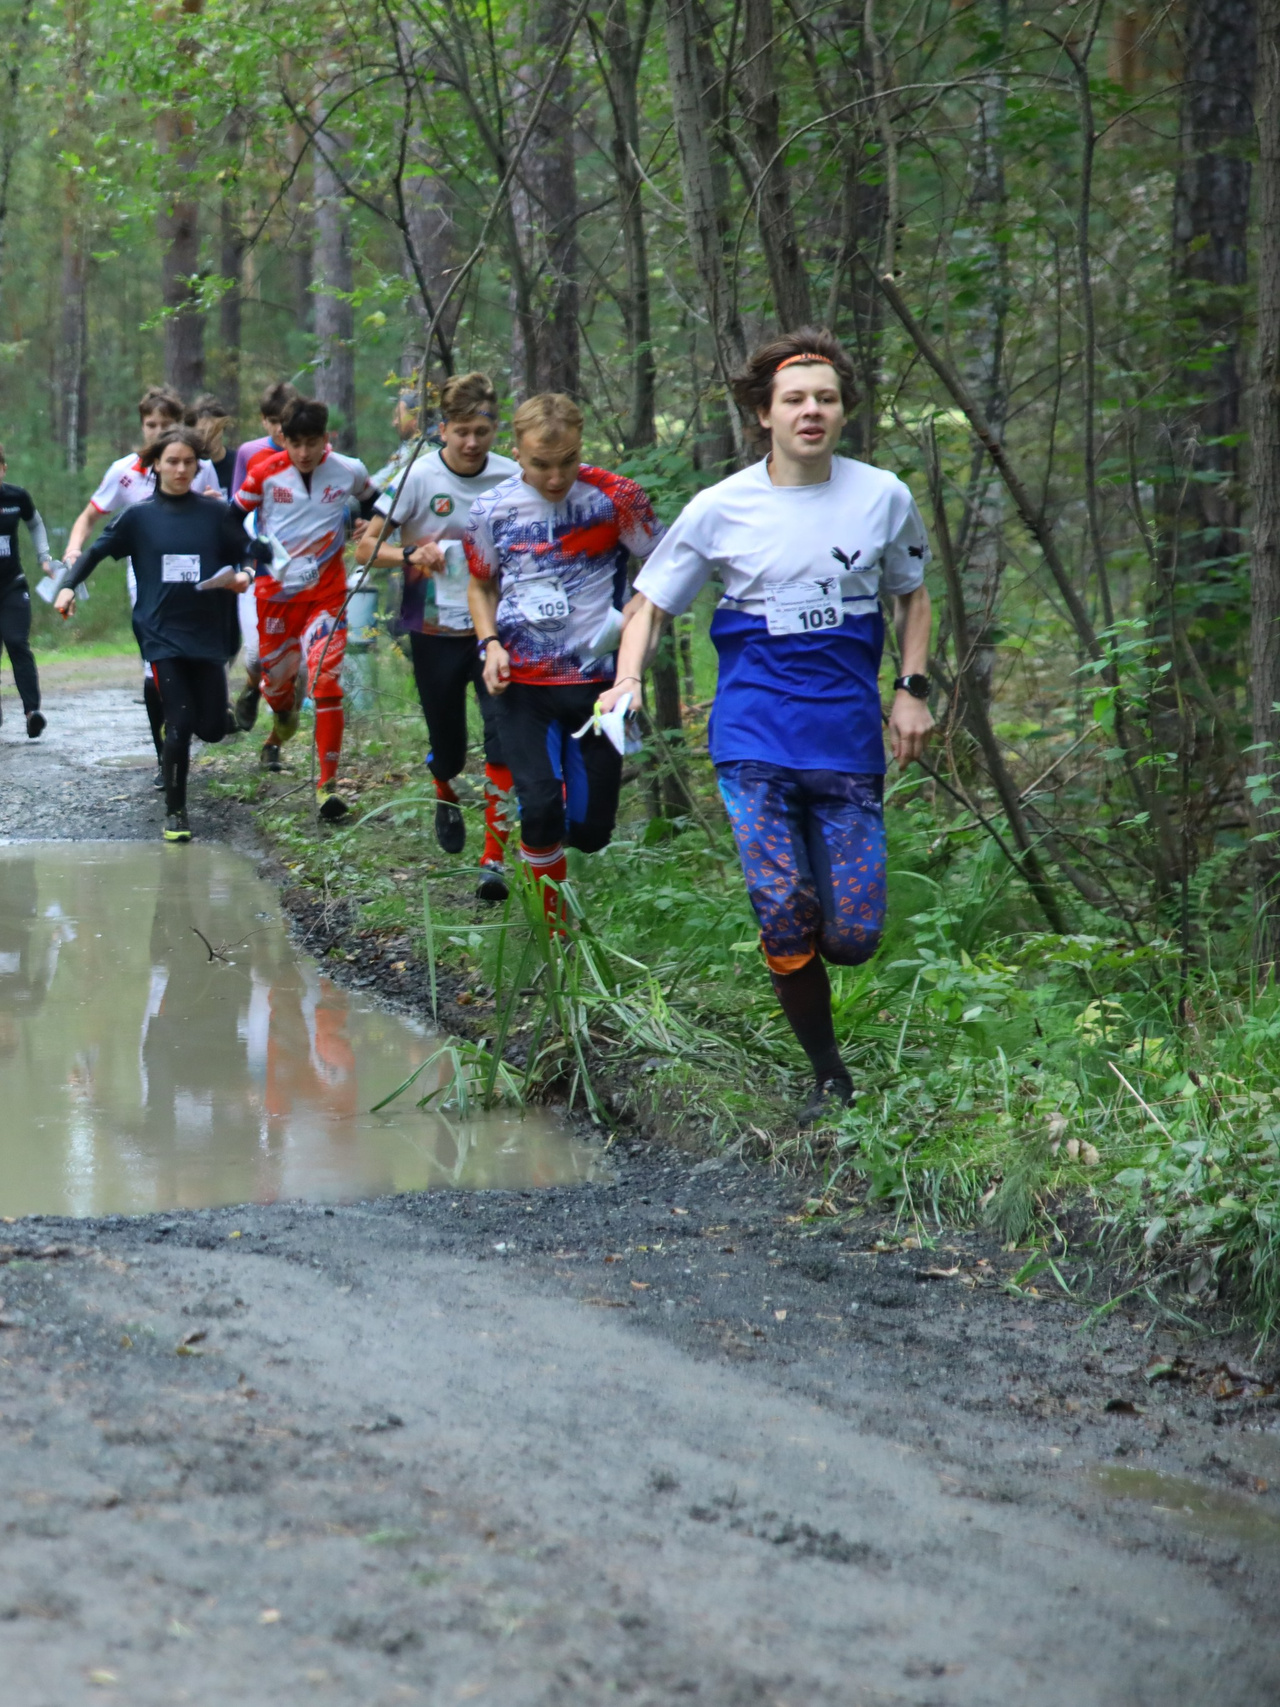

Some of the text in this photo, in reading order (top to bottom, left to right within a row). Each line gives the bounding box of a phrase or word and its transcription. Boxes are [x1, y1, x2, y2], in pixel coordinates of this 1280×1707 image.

[180, 571, 199, 582] 107
[538, 601, 565, 617] 109
[799, 607, 838, 629] 103
